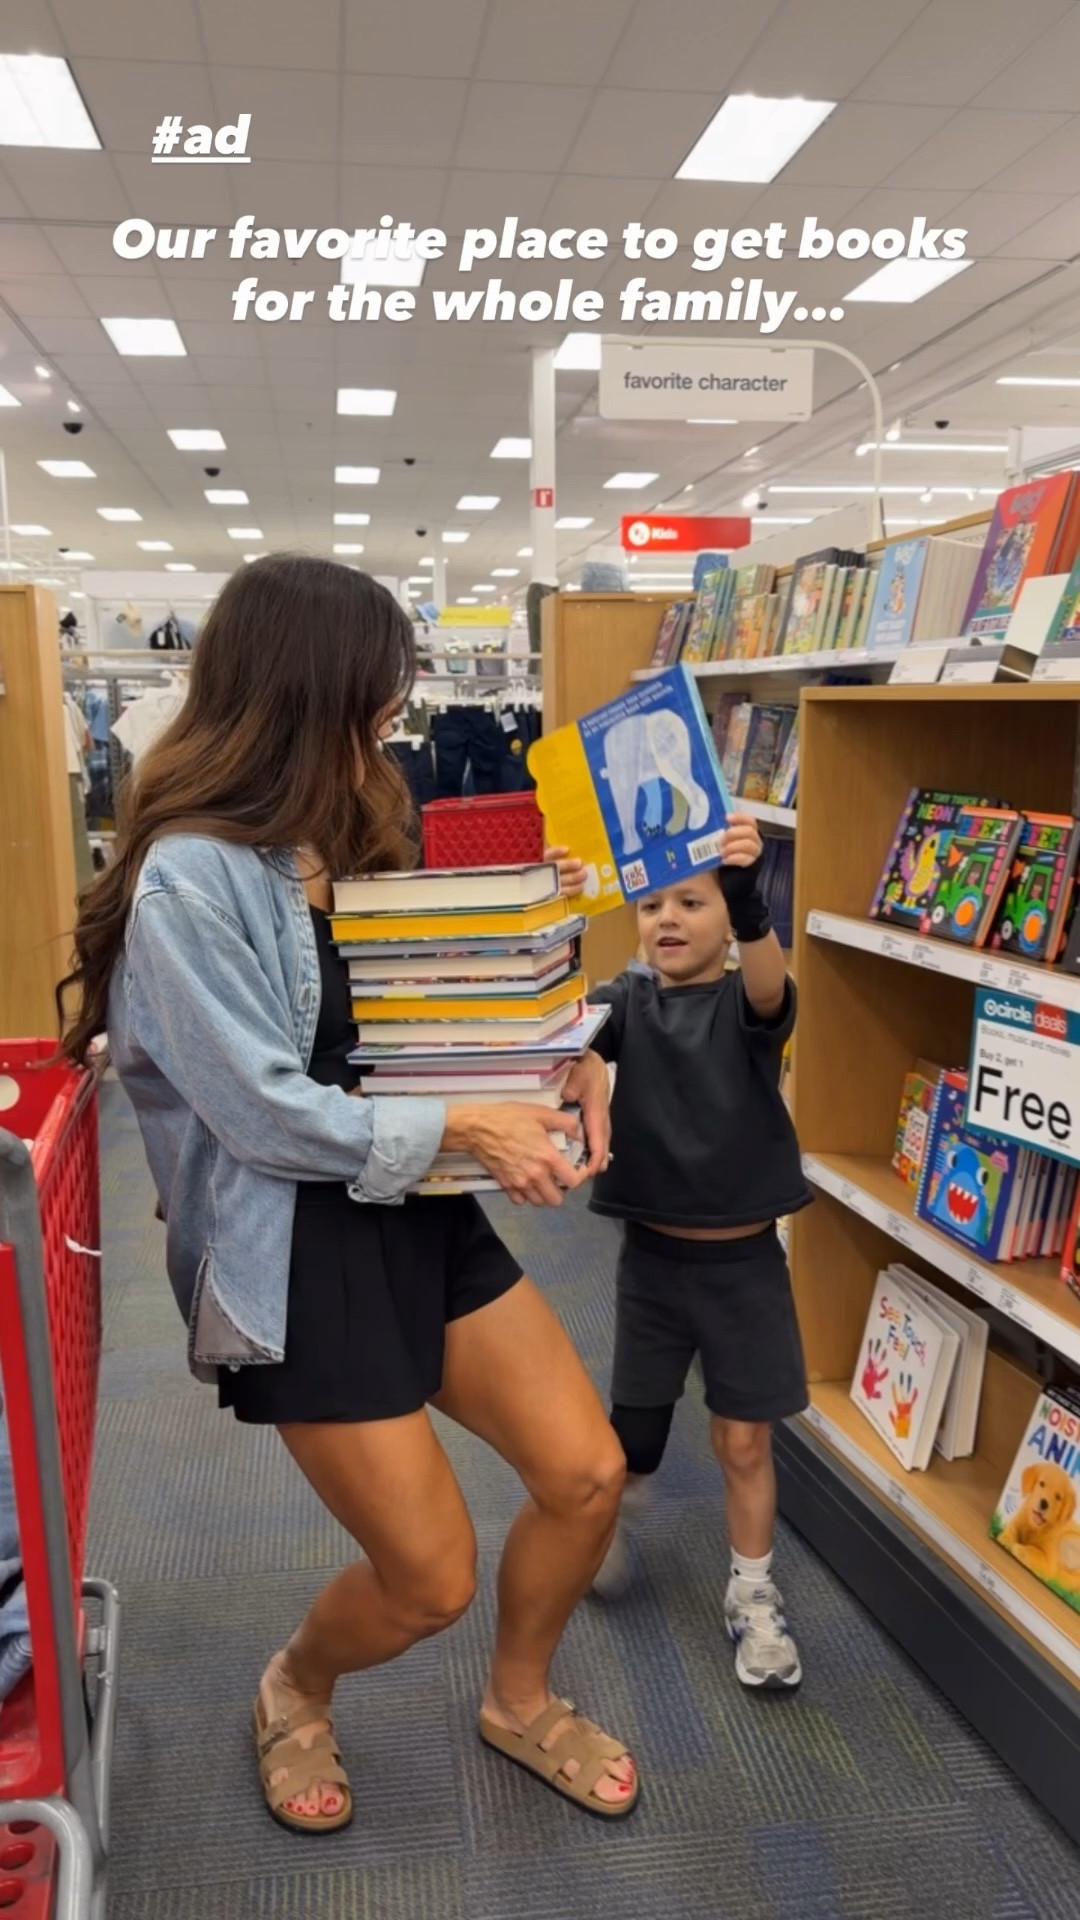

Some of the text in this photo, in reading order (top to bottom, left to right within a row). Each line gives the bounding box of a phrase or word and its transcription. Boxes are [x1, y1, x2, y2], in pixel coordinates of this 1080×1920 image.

[624, 371, 788, 392] favorite character
[651, 527, 679, 540] Kids
[917, 803, 954, 822] NEON
[996, 1001, 1068, 1034] circle deals
[979, 1048, 995, 1062] Buy
[1004, 1055, 1017, 1068] get
[974, 1064, 1072, 1141] Free
[1039, 1401, 1080, 1443] NOIS
